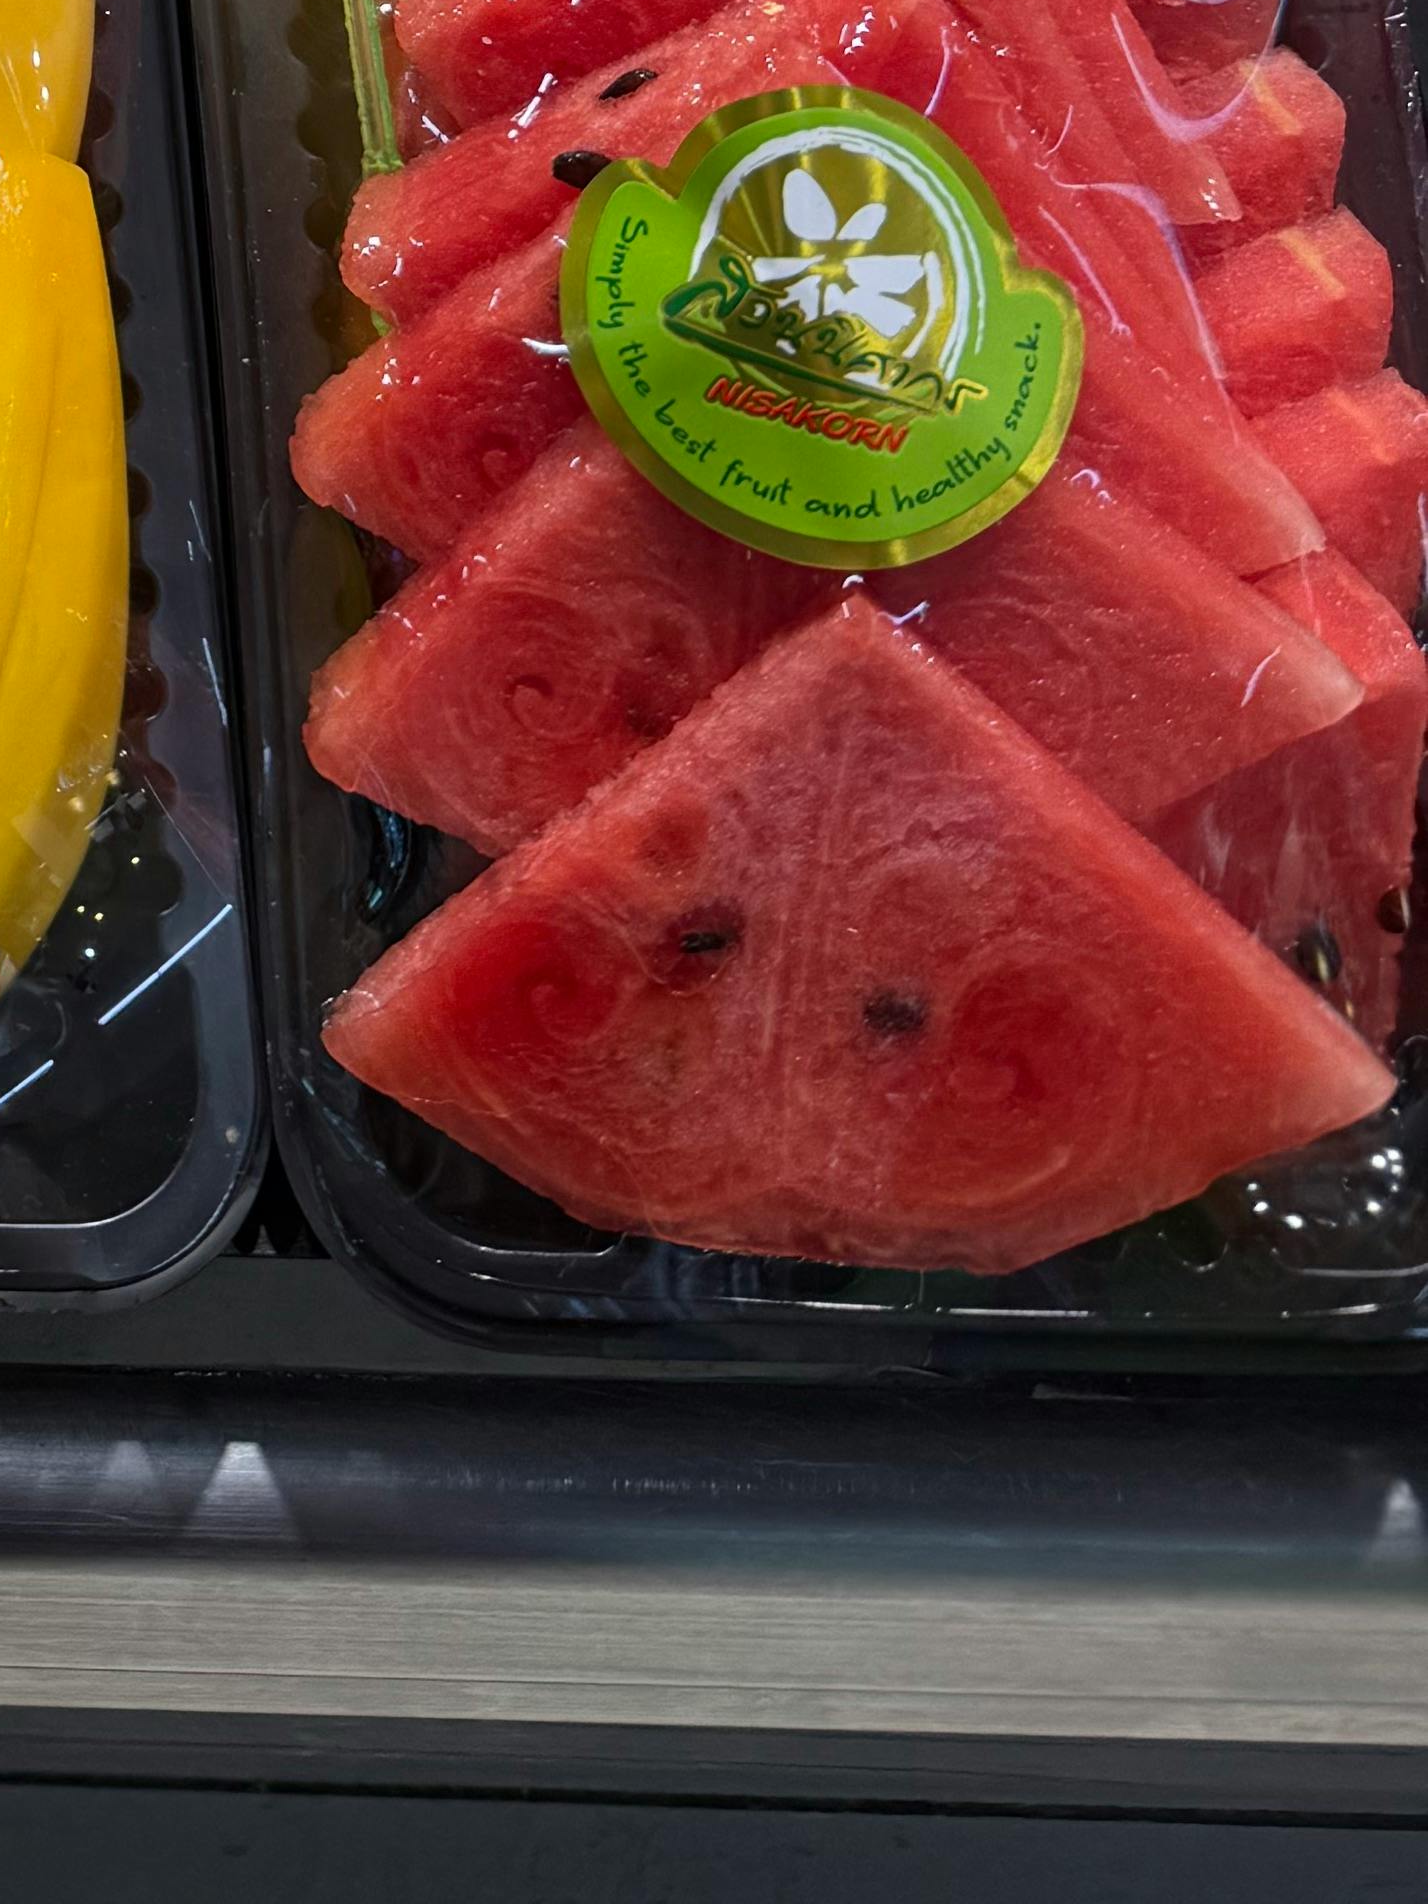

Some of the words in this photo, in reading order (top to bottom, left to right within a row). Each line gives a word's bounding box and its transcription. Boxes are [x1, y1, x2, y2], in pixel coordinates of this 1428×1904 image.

[597, 213, 650, 328] Simply
[621, 341, 650, 396] the
[1001, 321, 1042, 432] snack.
[655, 402, 715, 465] best
[702, 377, 910, 455] NISAKORN
[719, 459, 793, 507] fruit
[805, 494, 881, 516] and
[891, 438, 1010, 513] healthy
